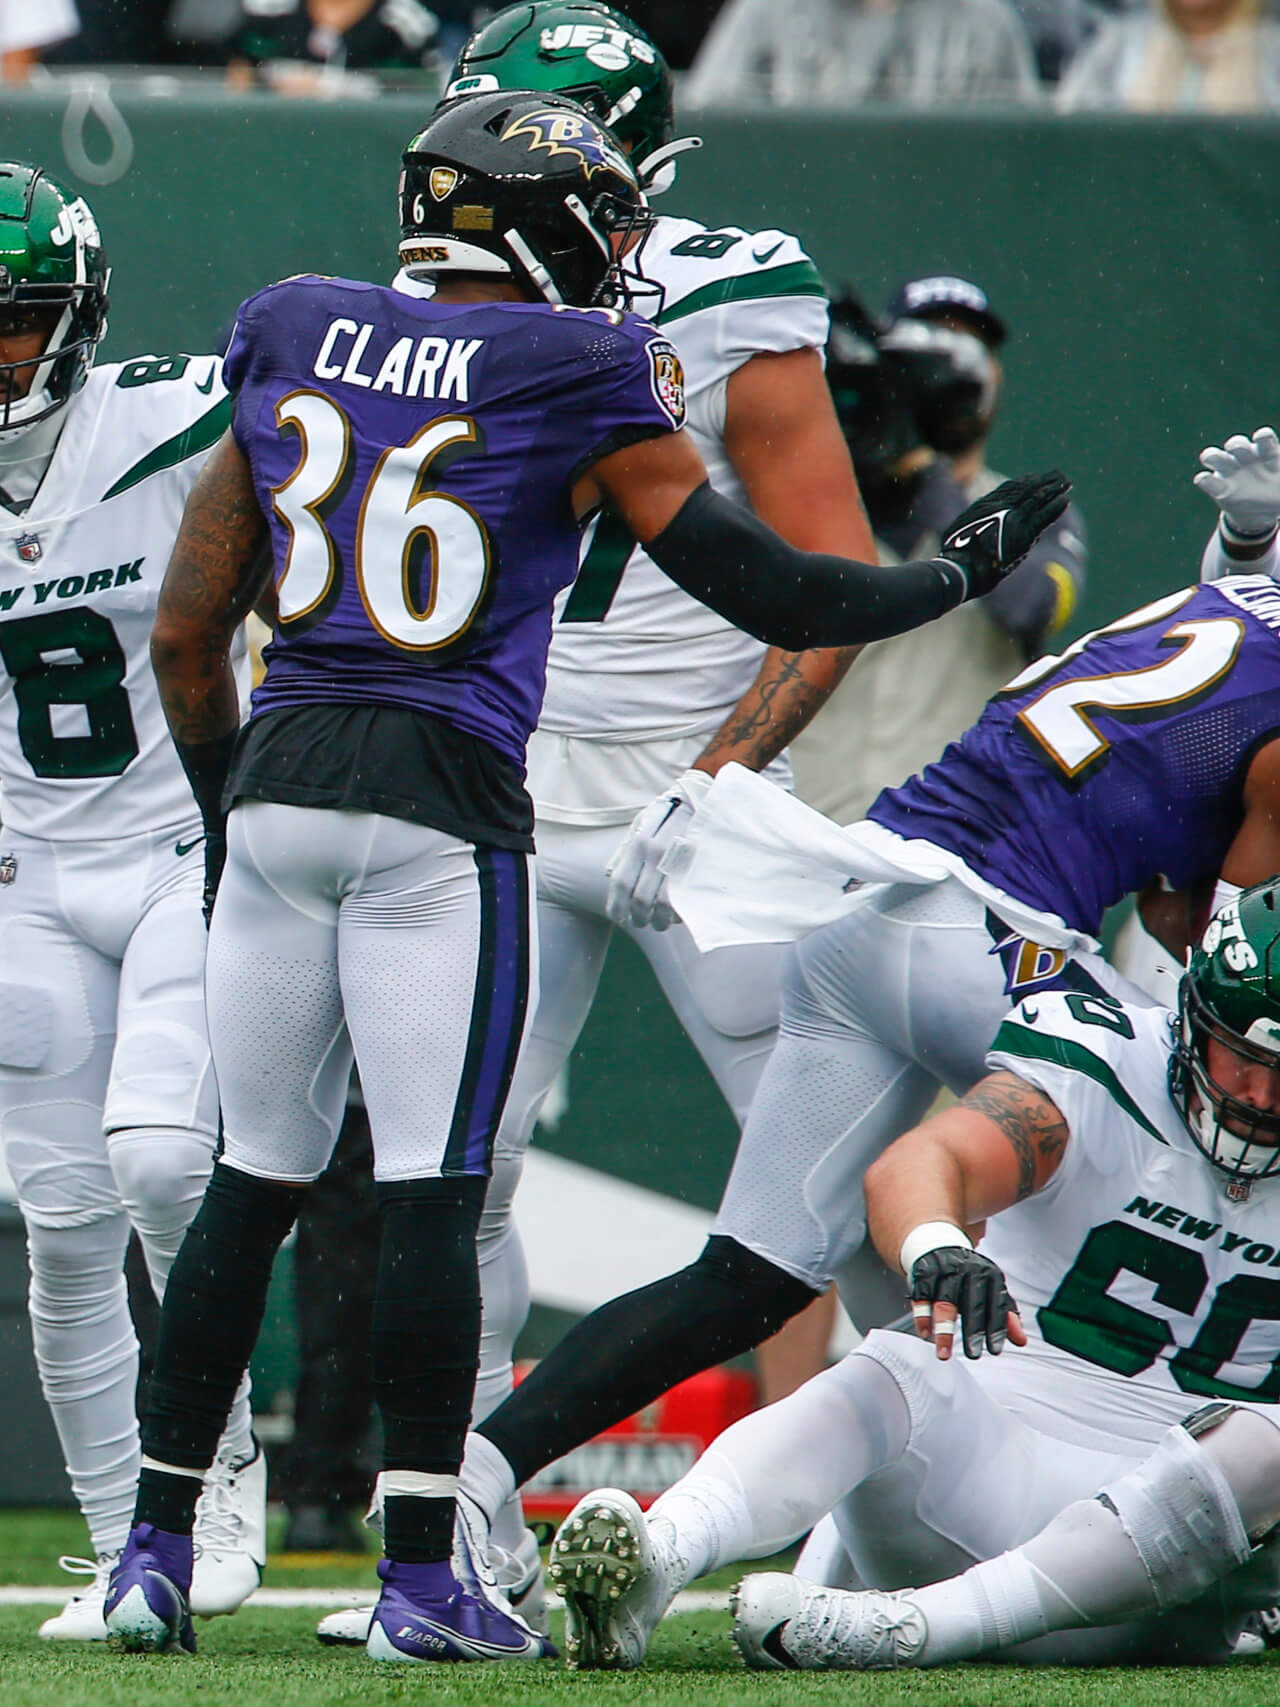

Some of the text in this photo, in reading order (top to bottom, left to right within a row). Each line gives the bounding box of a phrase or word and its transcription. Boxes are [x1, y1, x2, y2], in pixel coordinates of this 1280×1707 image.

[540, 24, 657, 65] JETS
[115, 354, 191, 389] 8
[313, 317, 485, 402] CLARK
[270, 387, 492, 654] 36
[33, 556, 146, 604] YORK
[1218, 897, 1260, 973] ETS
[1123, 1195, 1280, 1268] NEW YO
